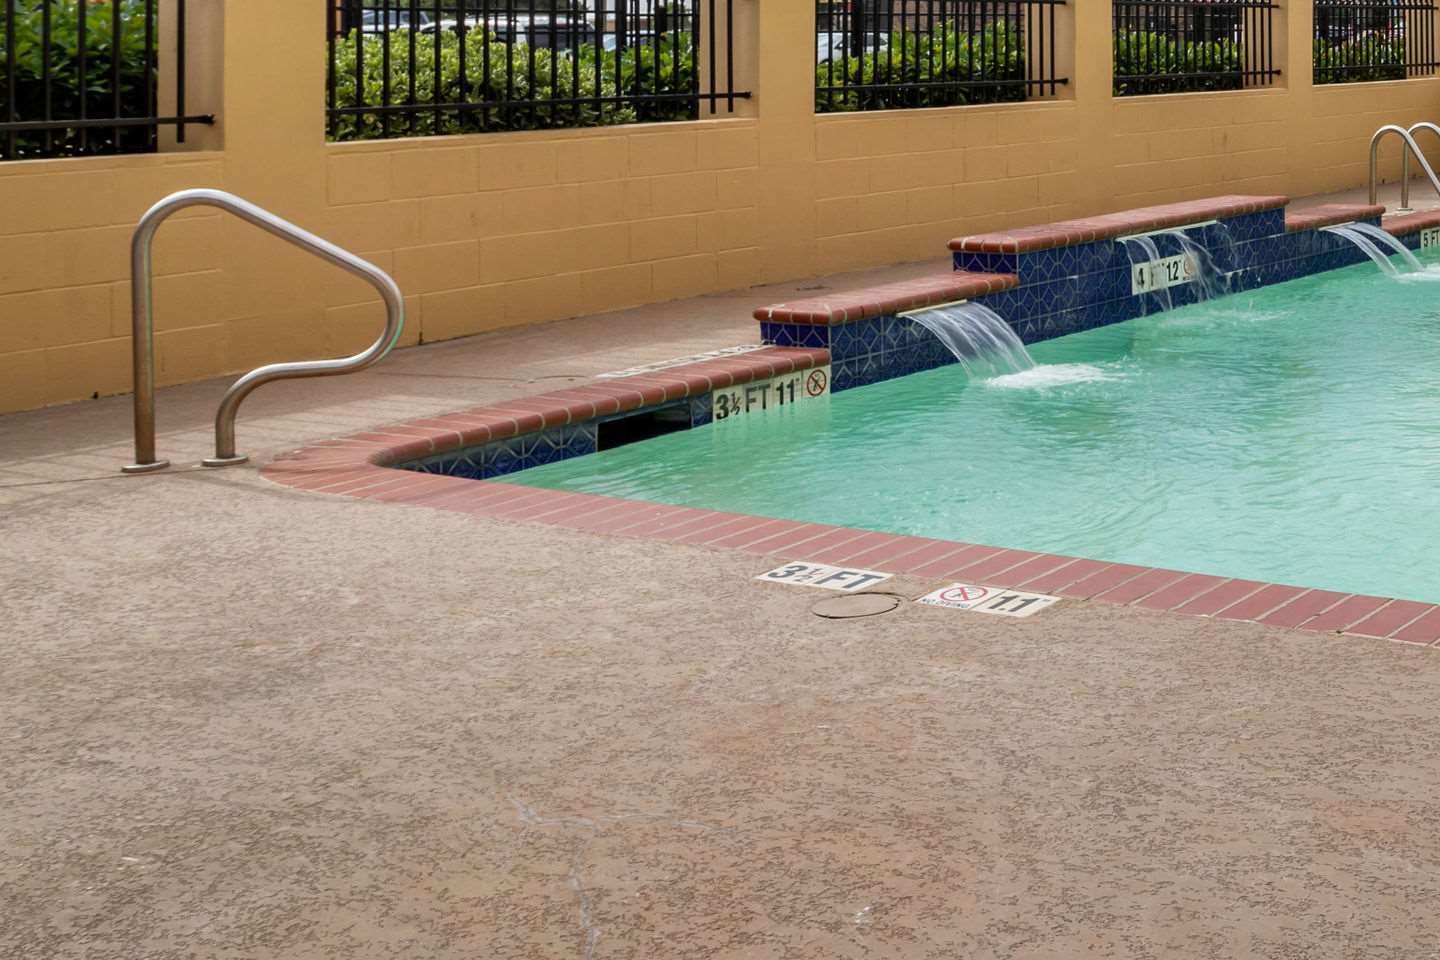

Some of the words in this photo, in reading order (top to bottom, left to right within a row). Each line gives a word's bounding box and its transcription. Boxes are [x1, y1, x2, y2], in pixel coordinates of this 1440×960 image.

[1423, 231, 1429, 248] 5
[1431, 229, 1440, 248] FT
[745, 383, 771, 413] FT
[812, 570, 886, 589] FT
